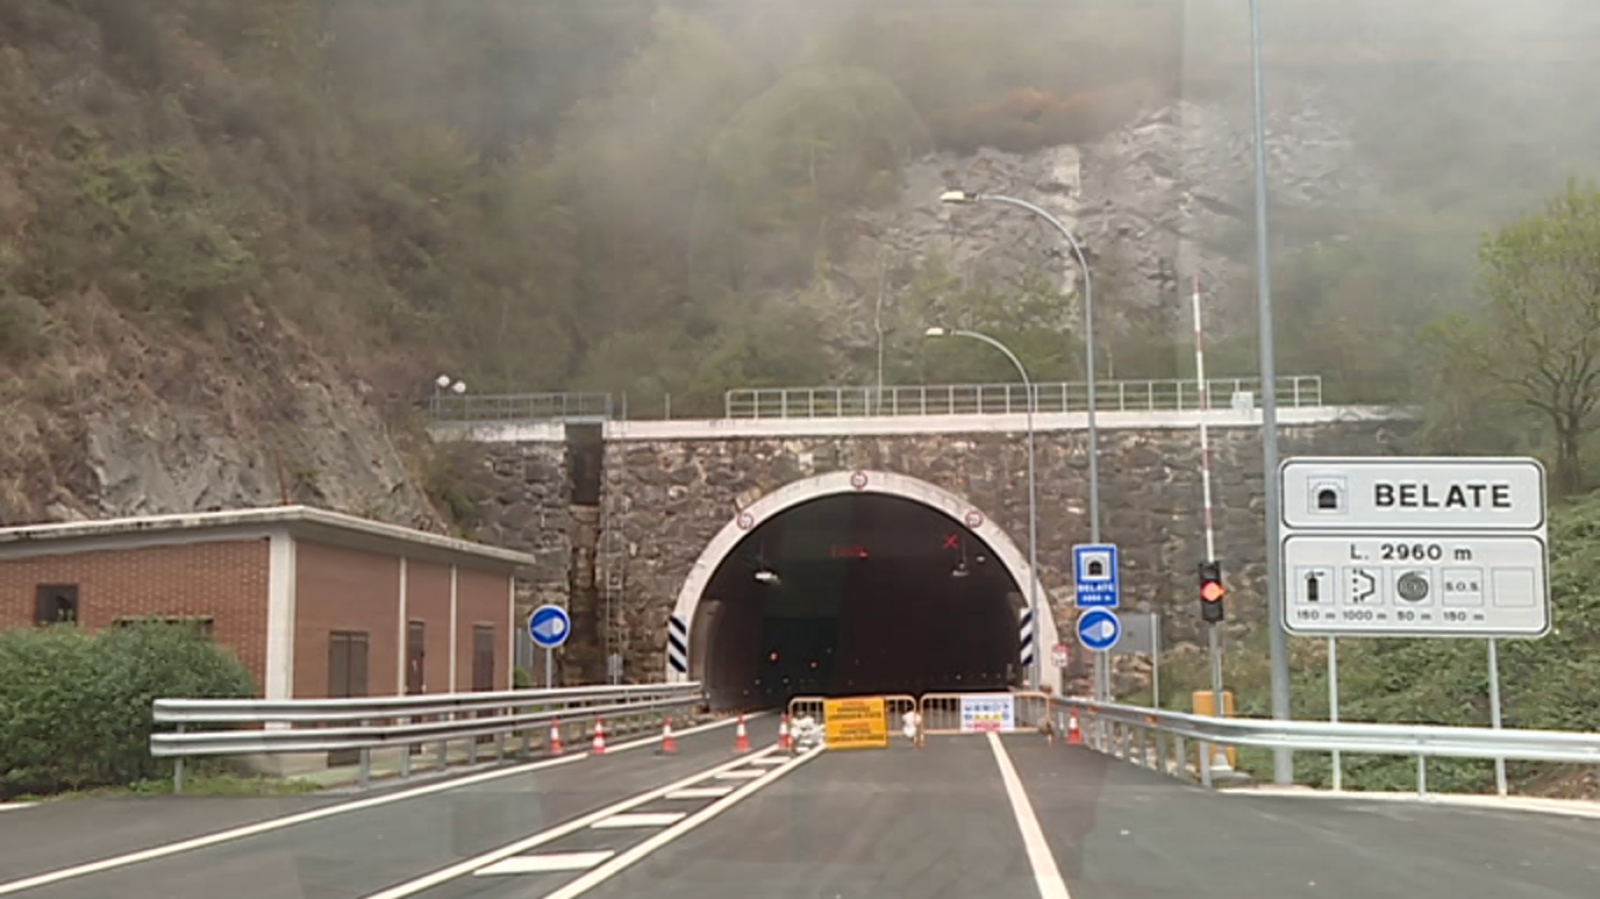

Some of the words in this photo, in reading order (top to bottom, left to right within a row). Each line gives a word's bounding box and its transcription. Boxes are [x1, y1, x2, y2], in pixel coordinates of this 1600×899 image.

[1374, 483, 1512, 508] BELATE
[1350, 544, 1370, 560] L.
[1380, 543, 1443, 560] 2960
[1454, 548, 1472, 561] m
[1343, 609, 1373, 621] 1000
